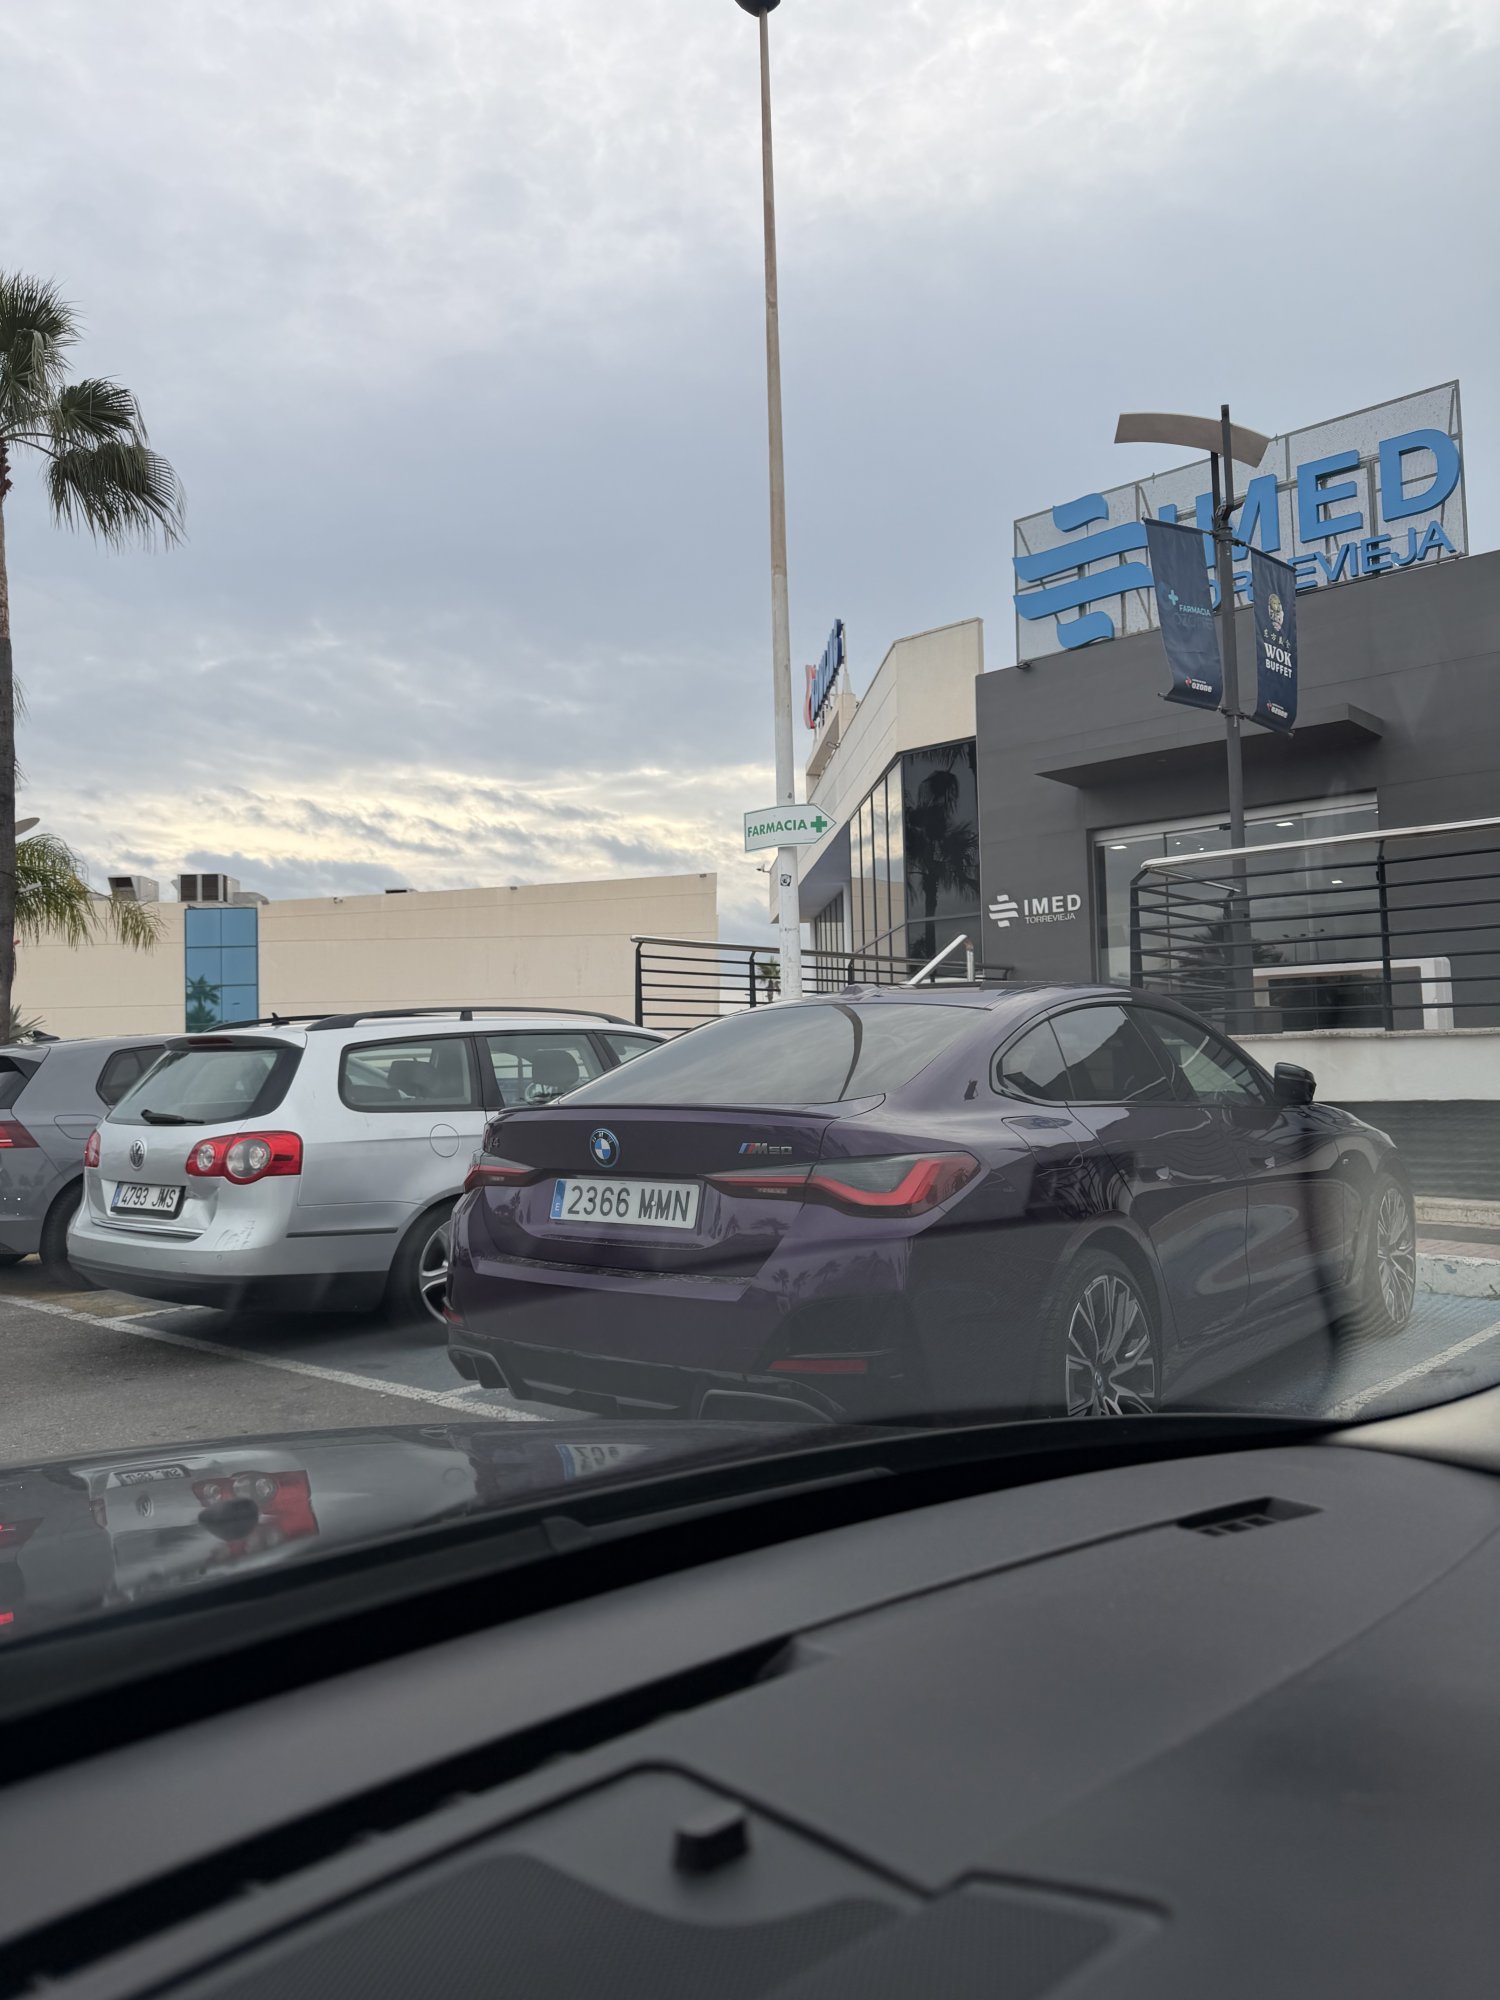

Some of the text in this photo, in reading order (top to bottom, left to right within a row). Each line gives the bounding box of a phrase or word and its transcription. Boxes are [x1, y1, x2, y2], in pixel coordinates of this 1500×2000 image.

[1159, 428, 1460, 569] MED
[1179, 604, 1211, 616] FARMACIA
[1264, 643, 1292, 667] WOK
[1265, 658, 1292, 678] BUFFET
[747, 819, 807, 838] FARMACIA
[1024, 894, 1081, 915] IMED
[1025, 913, 1076, 924] TORREVIEJA
[121, 1186, 149, 1206] 4793
[152, 1187, 176, 1208] JMS
[567, 1185, 691, 1222] 2366 MMN
